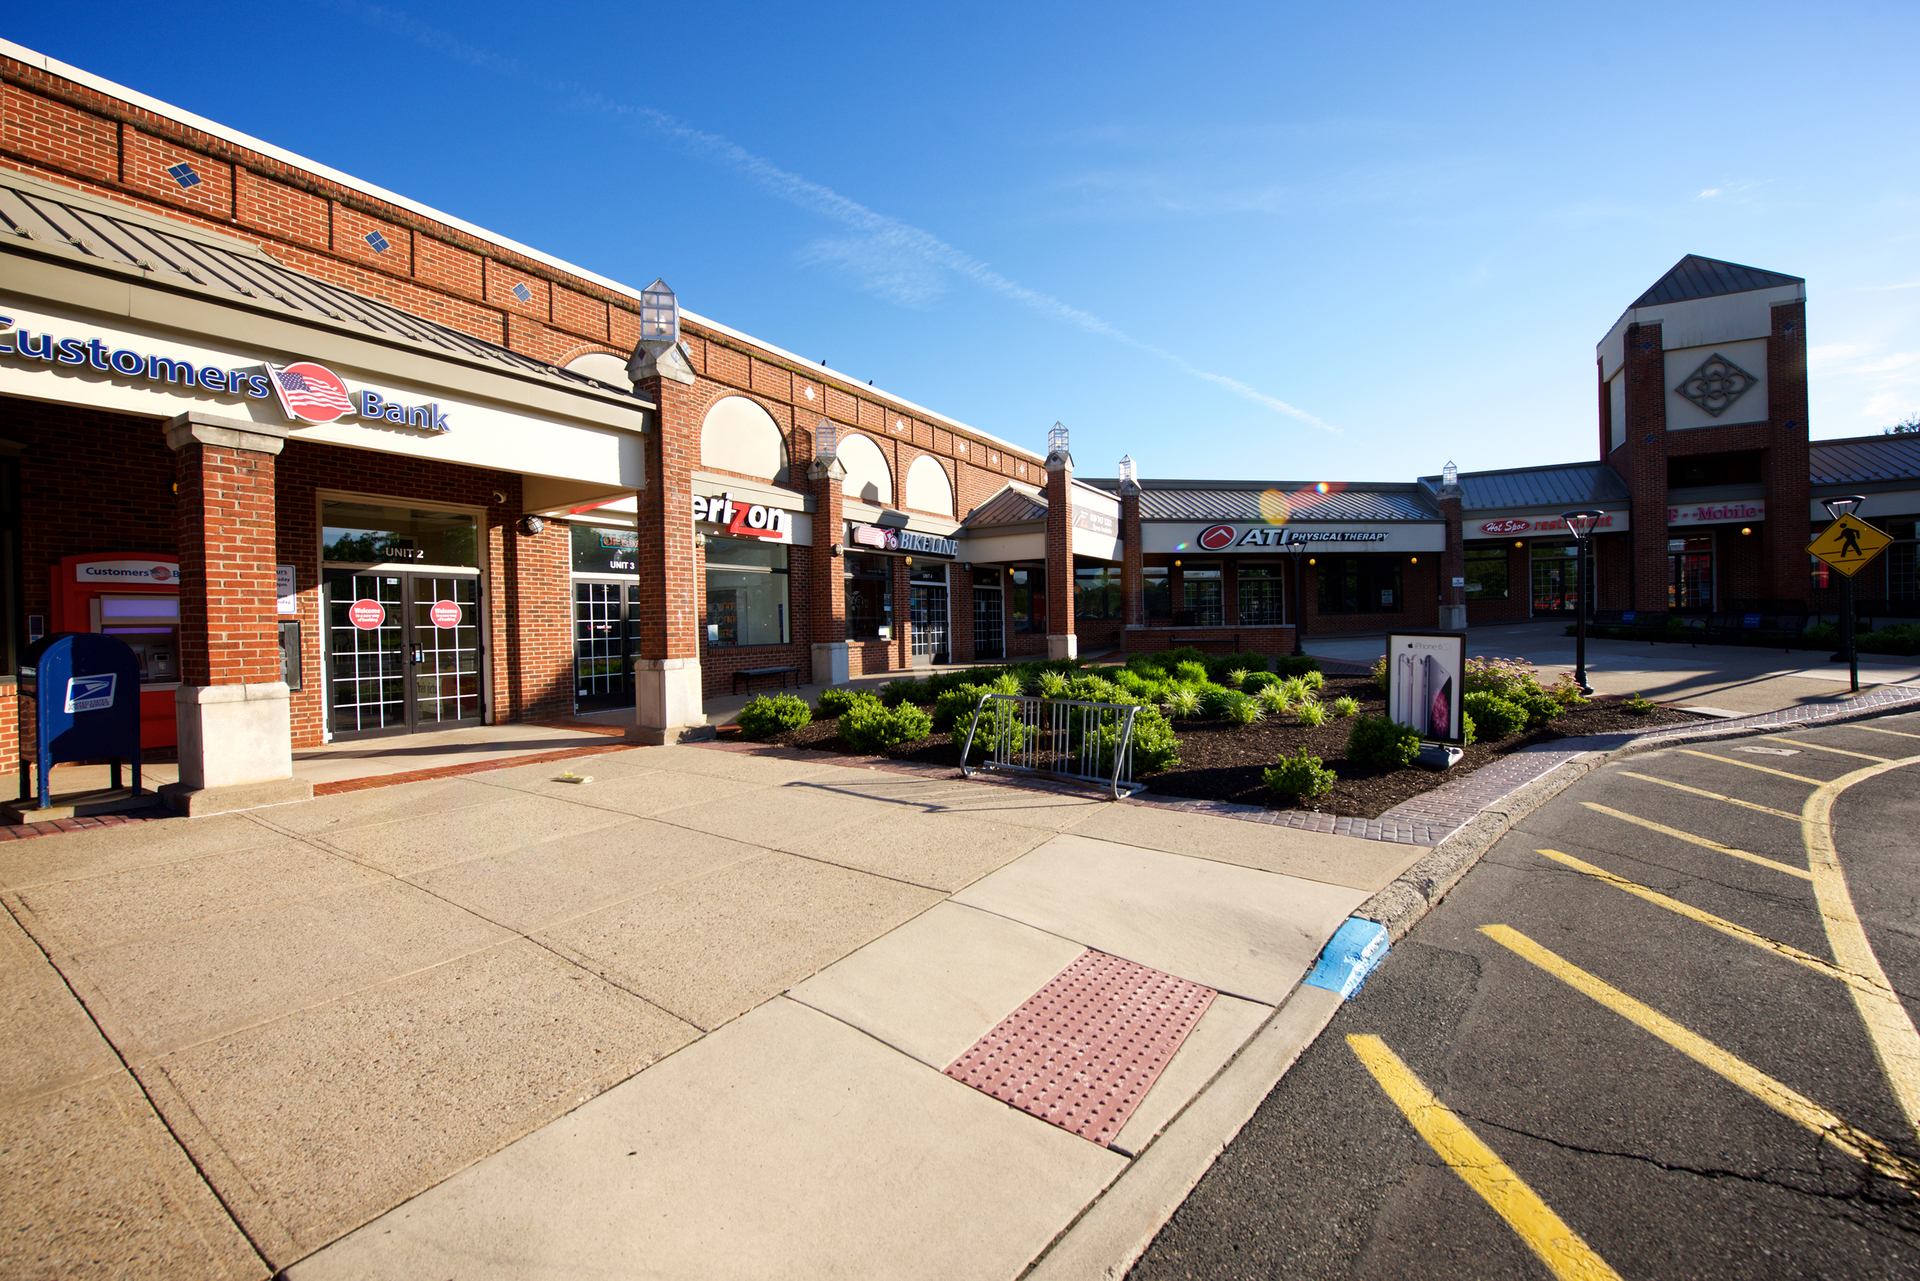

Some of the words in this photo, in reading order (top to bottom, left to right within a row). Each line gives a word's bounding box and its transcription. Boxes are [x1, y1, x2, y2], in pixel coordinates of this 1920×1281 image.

[361, 389, 452, 433] Bank
[693, 492, 785, 538] erizon
[1486, 522, 1503, 533] Hot
[1504, 520, 1526, 534] Spot
[1237, 528, 1289, 546] ATI
[1291, 532, 1342, 541] PHYSICAL
[1344, 532, 1389, 541] THERAPY
[900, 532, 930, 552] BIKE
[931, 538, 959, 556] LINE
[385, 547, 414, 558] UNIT
[416, 549, 424, 559] 2
[85, 566, 149, 577] Customers
[610, 561, 629, 570] UNIT
[629, 562, 635, 570] 3
[1415, 642, 1438, 651] iPhone
